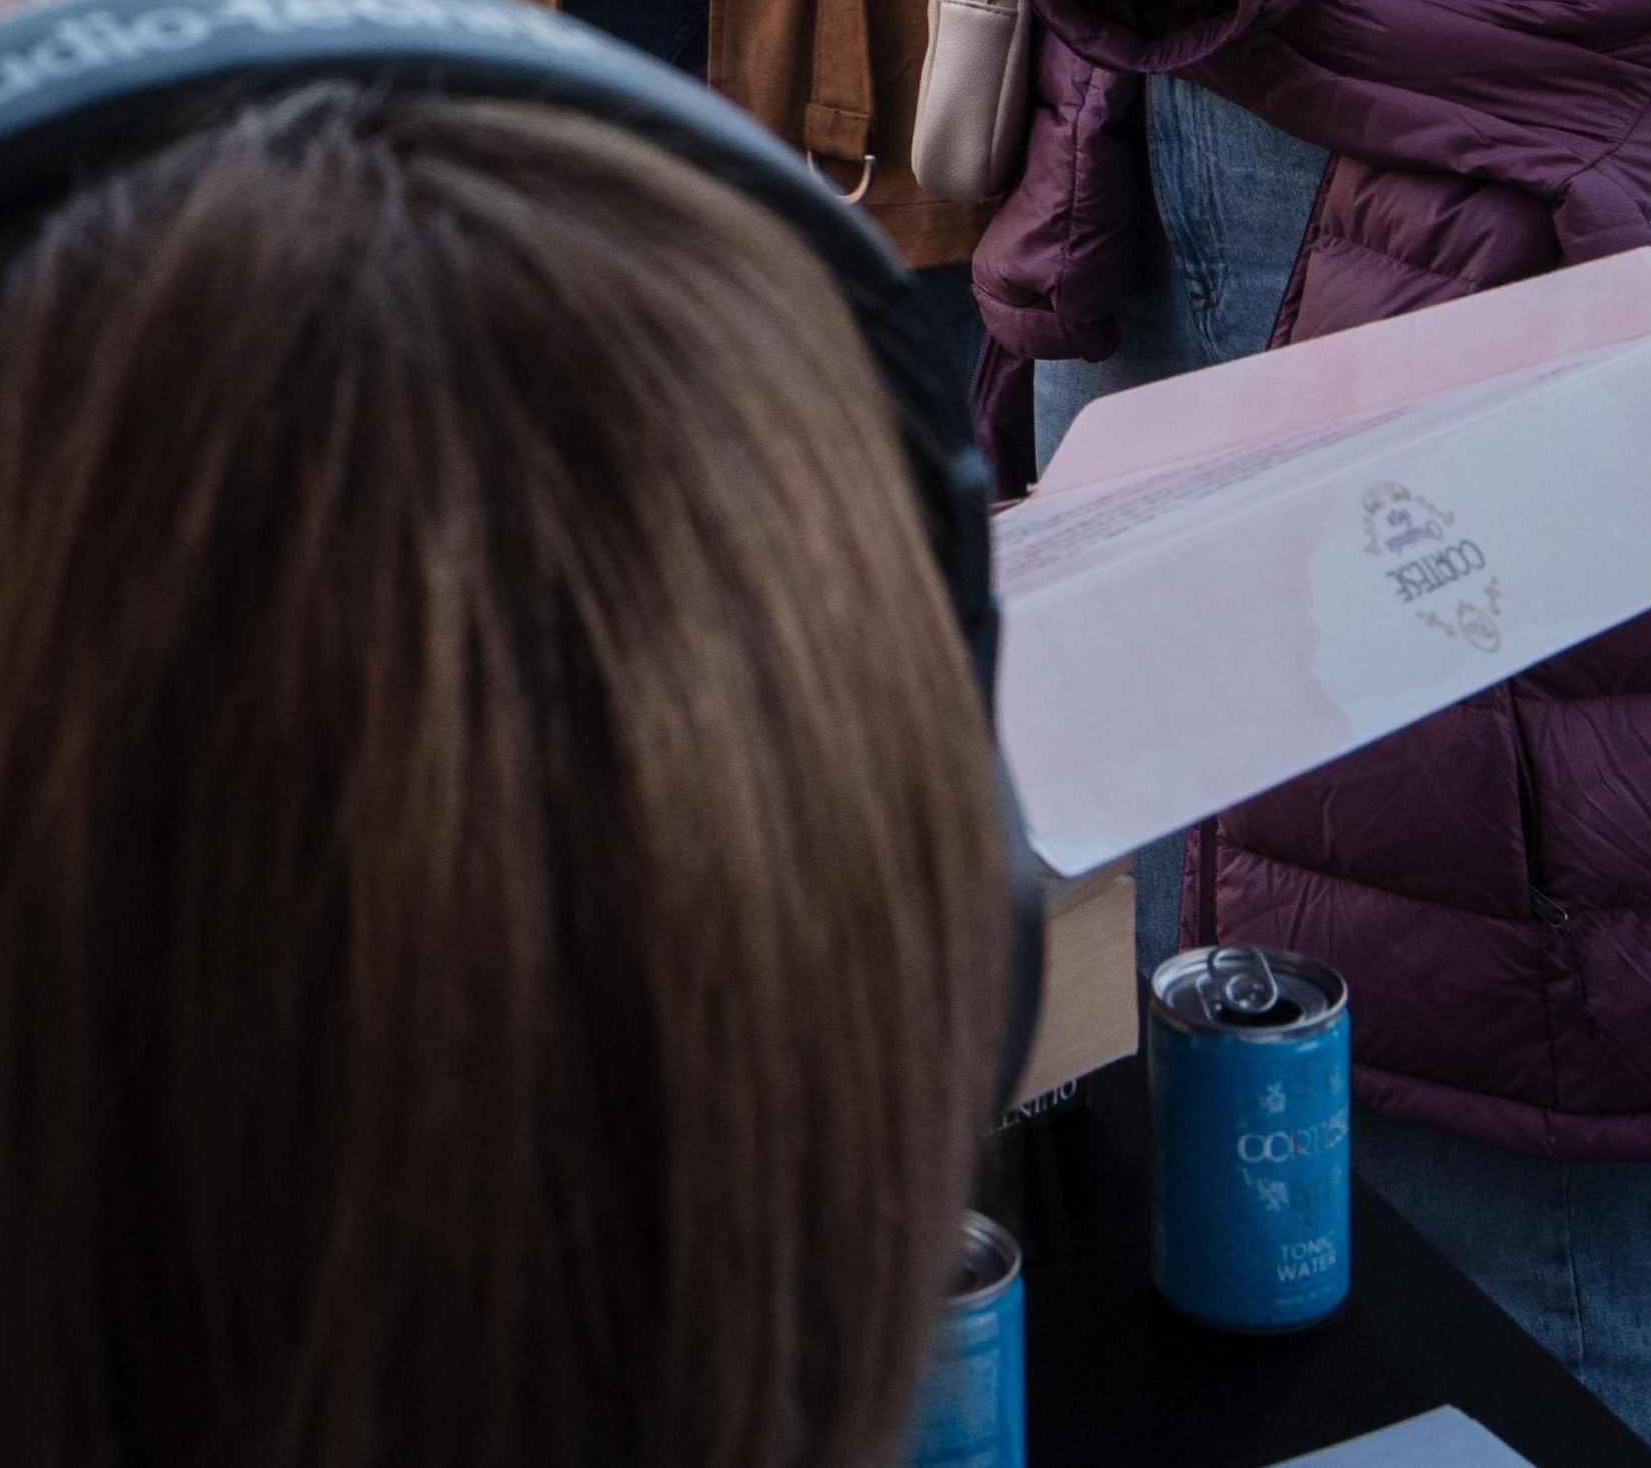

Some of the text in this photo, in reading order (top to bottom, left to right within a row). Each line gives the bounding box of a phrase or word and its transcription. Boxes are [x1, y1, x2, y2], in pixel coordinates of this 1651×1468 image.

[1383, 538, 1487, 604] CORTESE
[1275, 1248, 1338, 1283] WATER
[1280, 1234, 1336, 1262] TONIC
